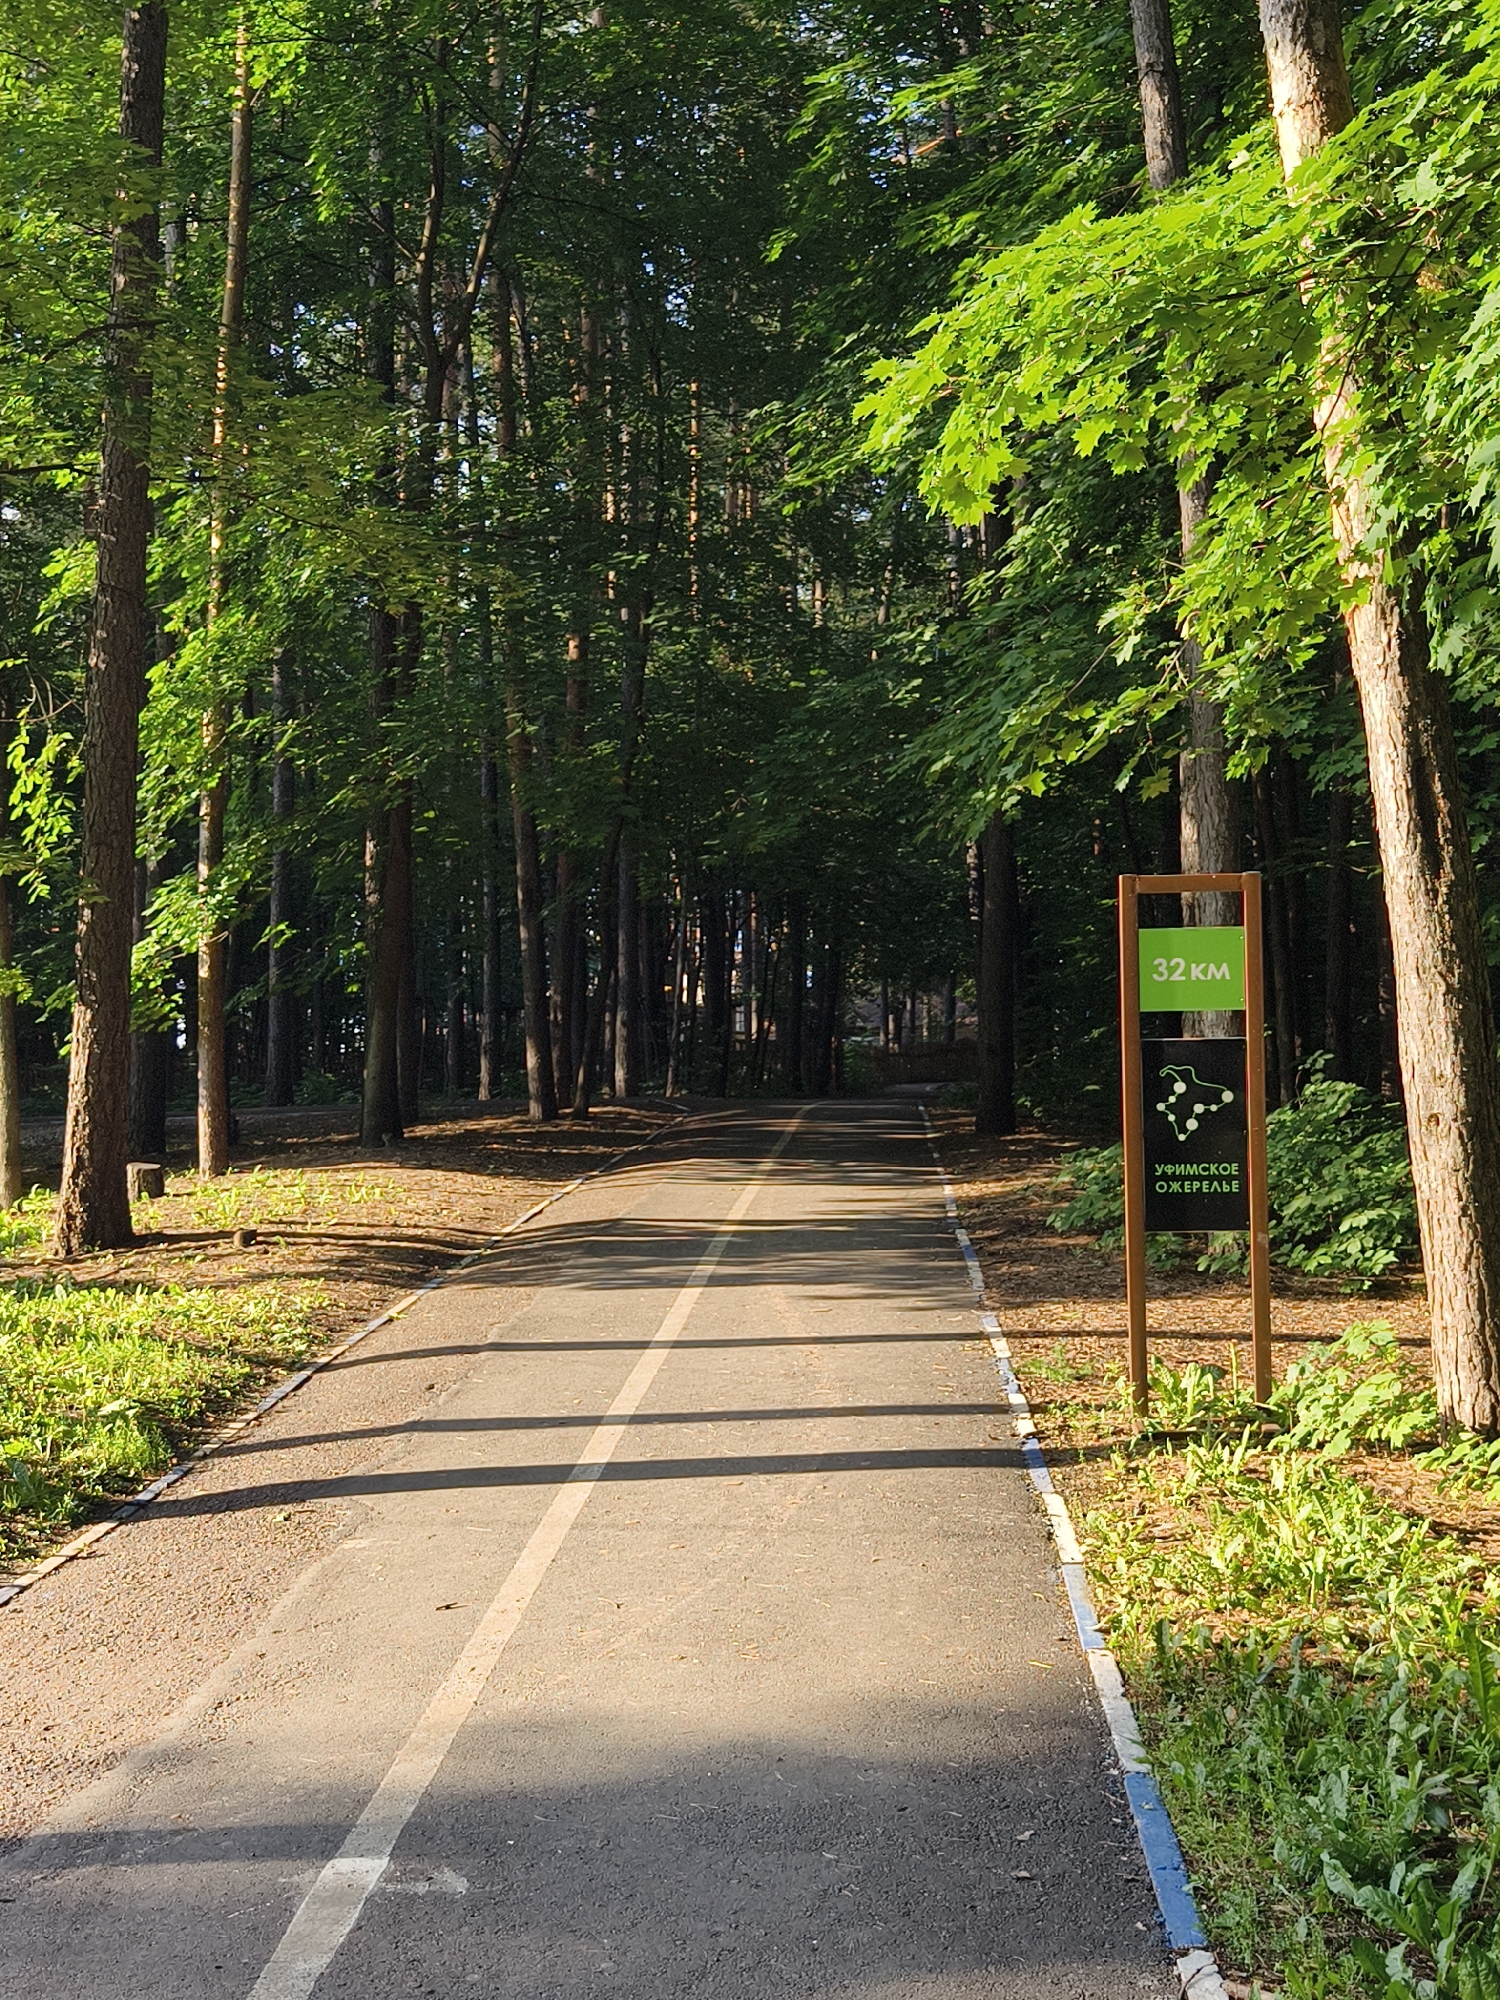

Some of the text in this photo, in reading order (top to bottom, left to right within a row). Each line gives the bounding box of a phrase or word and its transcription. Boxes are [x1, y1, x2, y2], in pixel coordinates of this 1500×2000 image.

[1152, 957, 1186, 982] 32
[1154, 1163, 1239, 1176] УФИМСКОЕ
[1155, 1181, 1240, 1193] ОЖЕРЕЛЬЕ
